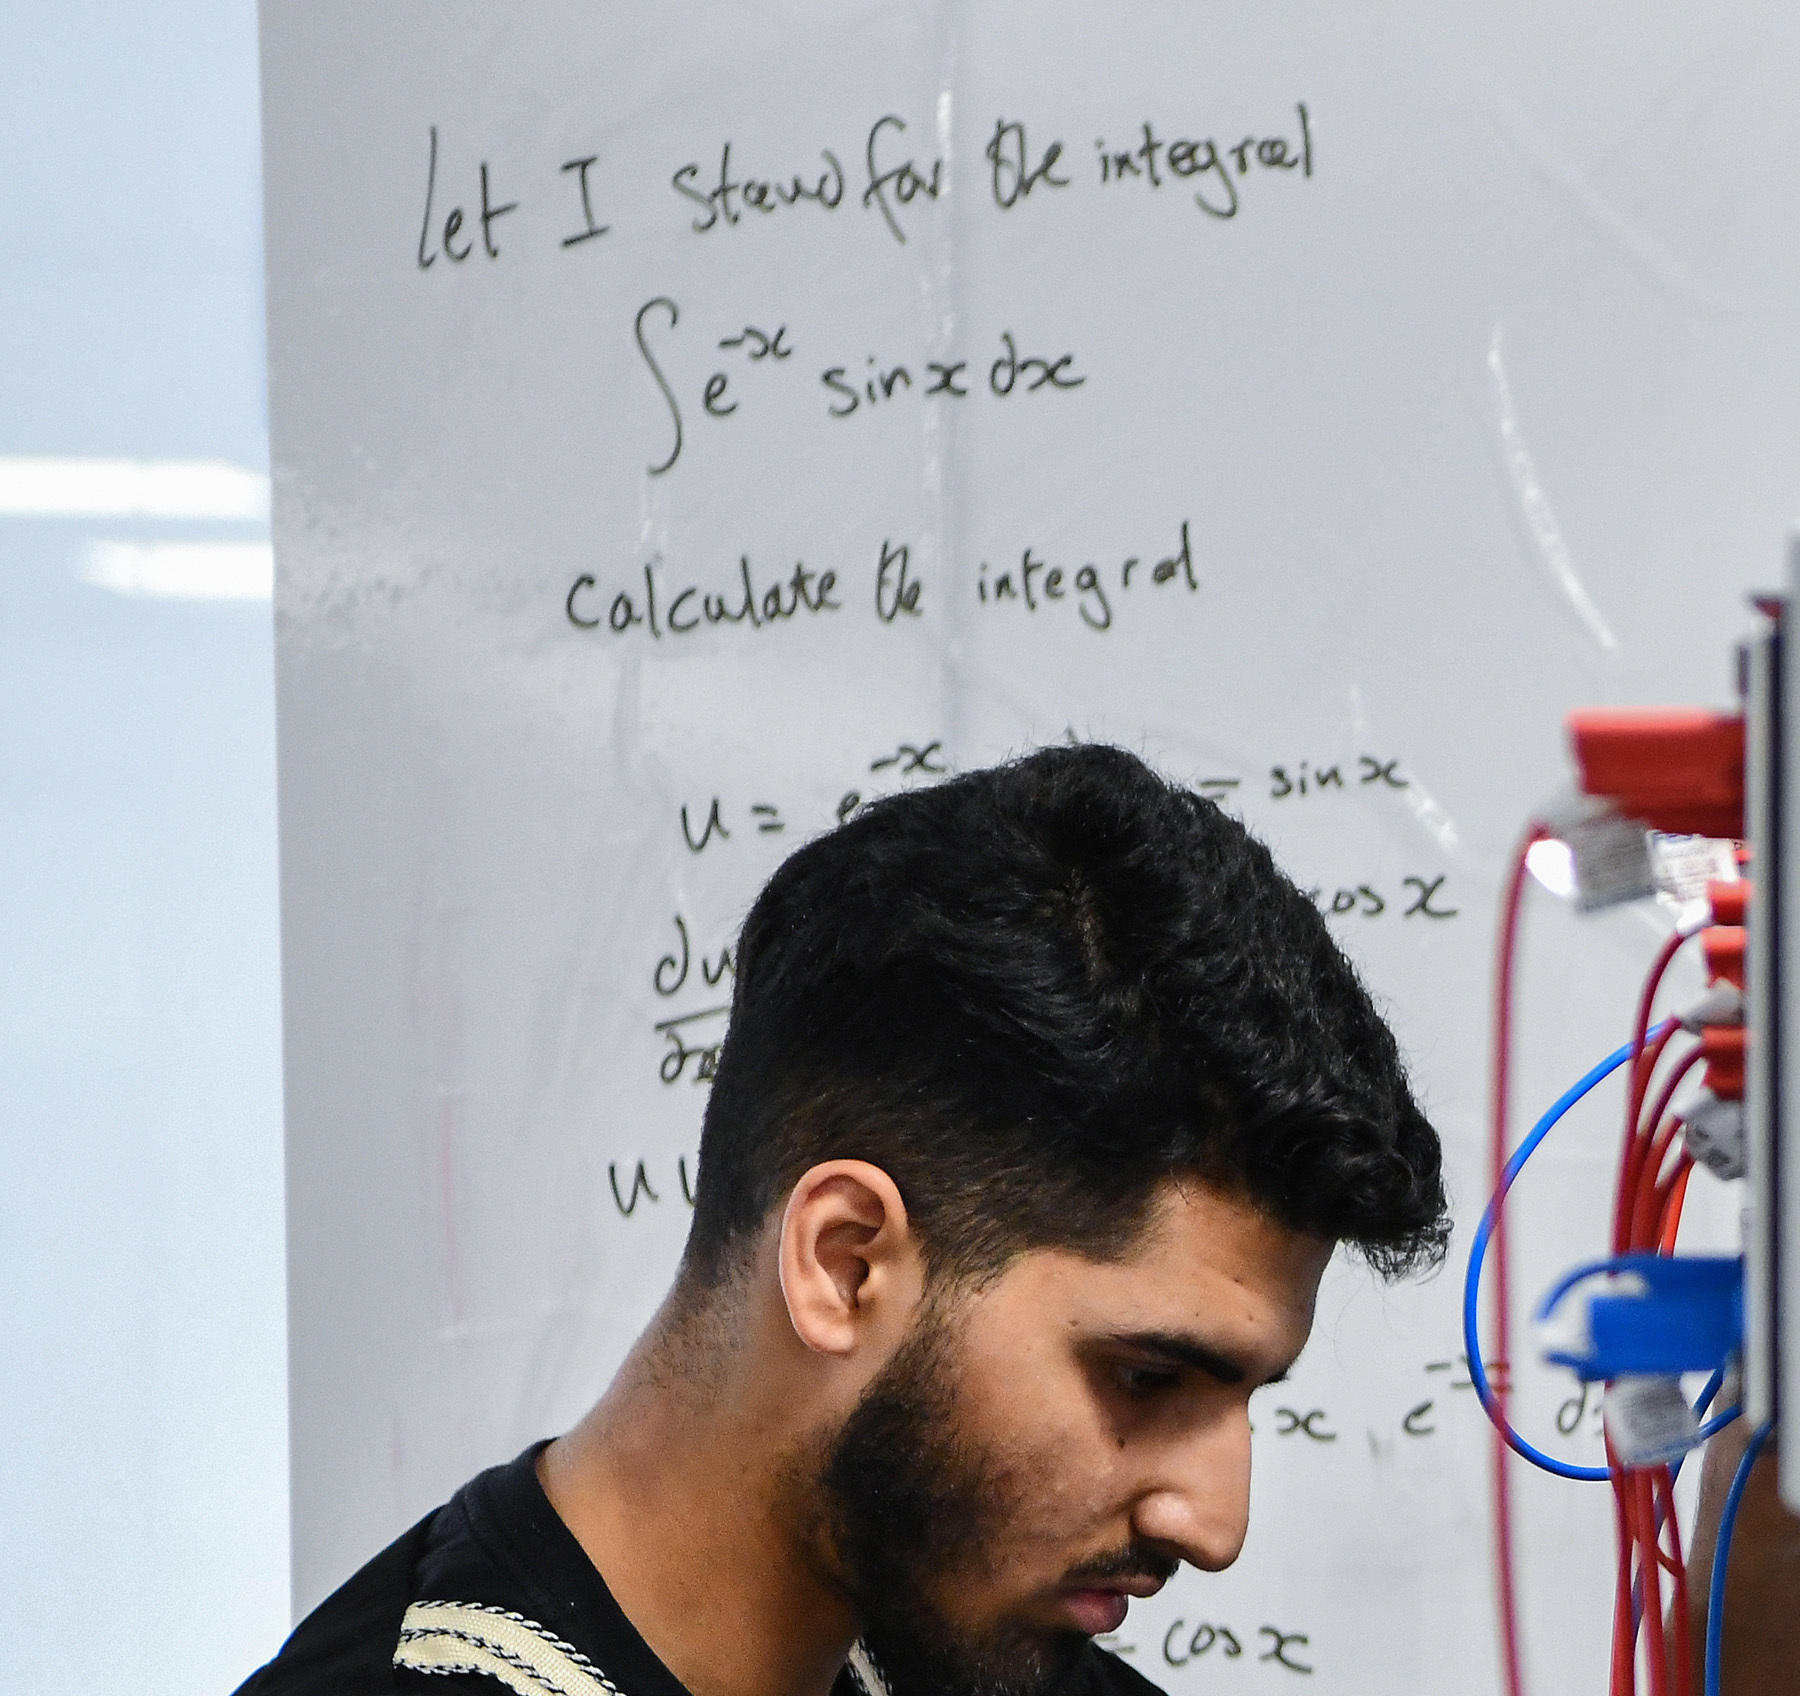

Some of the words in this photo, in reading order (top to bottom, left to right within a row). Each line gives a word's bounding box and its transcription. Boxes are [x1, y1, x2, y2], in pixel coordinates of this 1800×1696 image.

[560, 155, 609, 249] I
[862, 115, 942, 244] for
[985, 119, 1070, 211] the
[1098, 102, 1313, 220] integral
[874, 540, 924, 625] the
[977, 520, 1200, 633] integral
